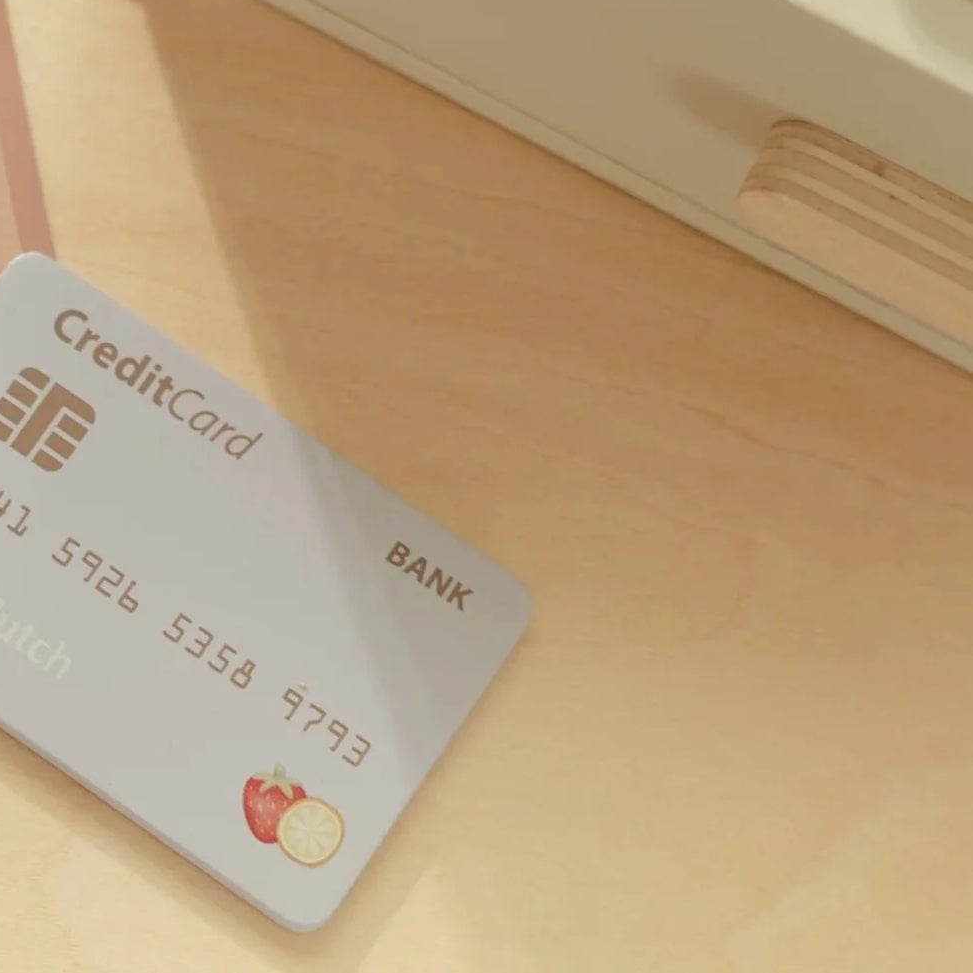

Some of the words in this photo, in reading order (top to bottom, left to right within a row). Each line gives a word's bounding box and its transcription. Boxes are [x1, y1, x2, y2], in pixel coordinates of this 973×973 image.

[53, 308, 263, 460] CreditCard
[51, 536, 140, 614] 5926
[163, 612, 257, 690] 5358
[282, 687, 372, 768] 9793
[385, 540, 475, 612] BANK
